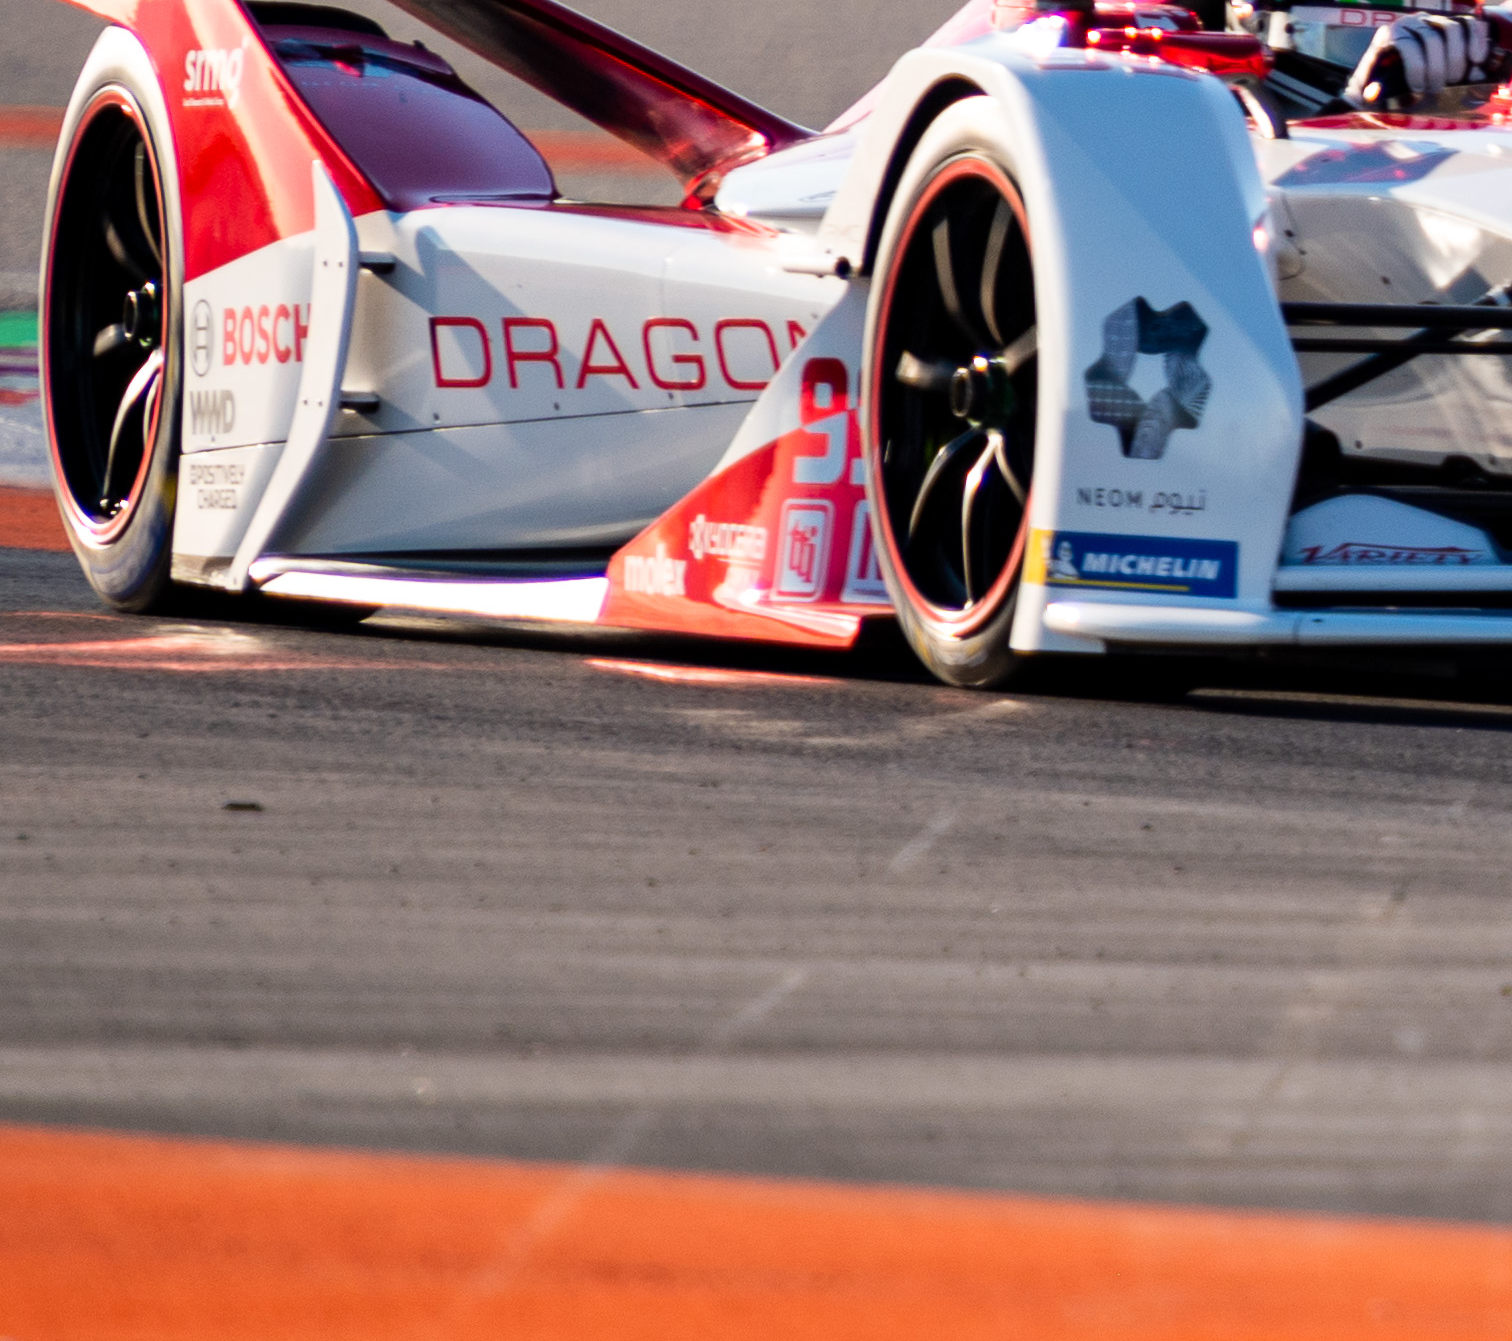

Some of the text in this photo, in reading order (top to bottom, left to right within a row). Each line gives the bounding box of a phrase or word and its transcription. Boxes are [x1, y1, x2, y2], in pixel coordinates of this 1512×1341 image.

[223, 303, 311, 366] BOSCH
[429, 316, 808, 392] DRAGO
[1075, 486, 1144, 509] NEOM
[1080, 552, 1222, 581] MICHELIN
